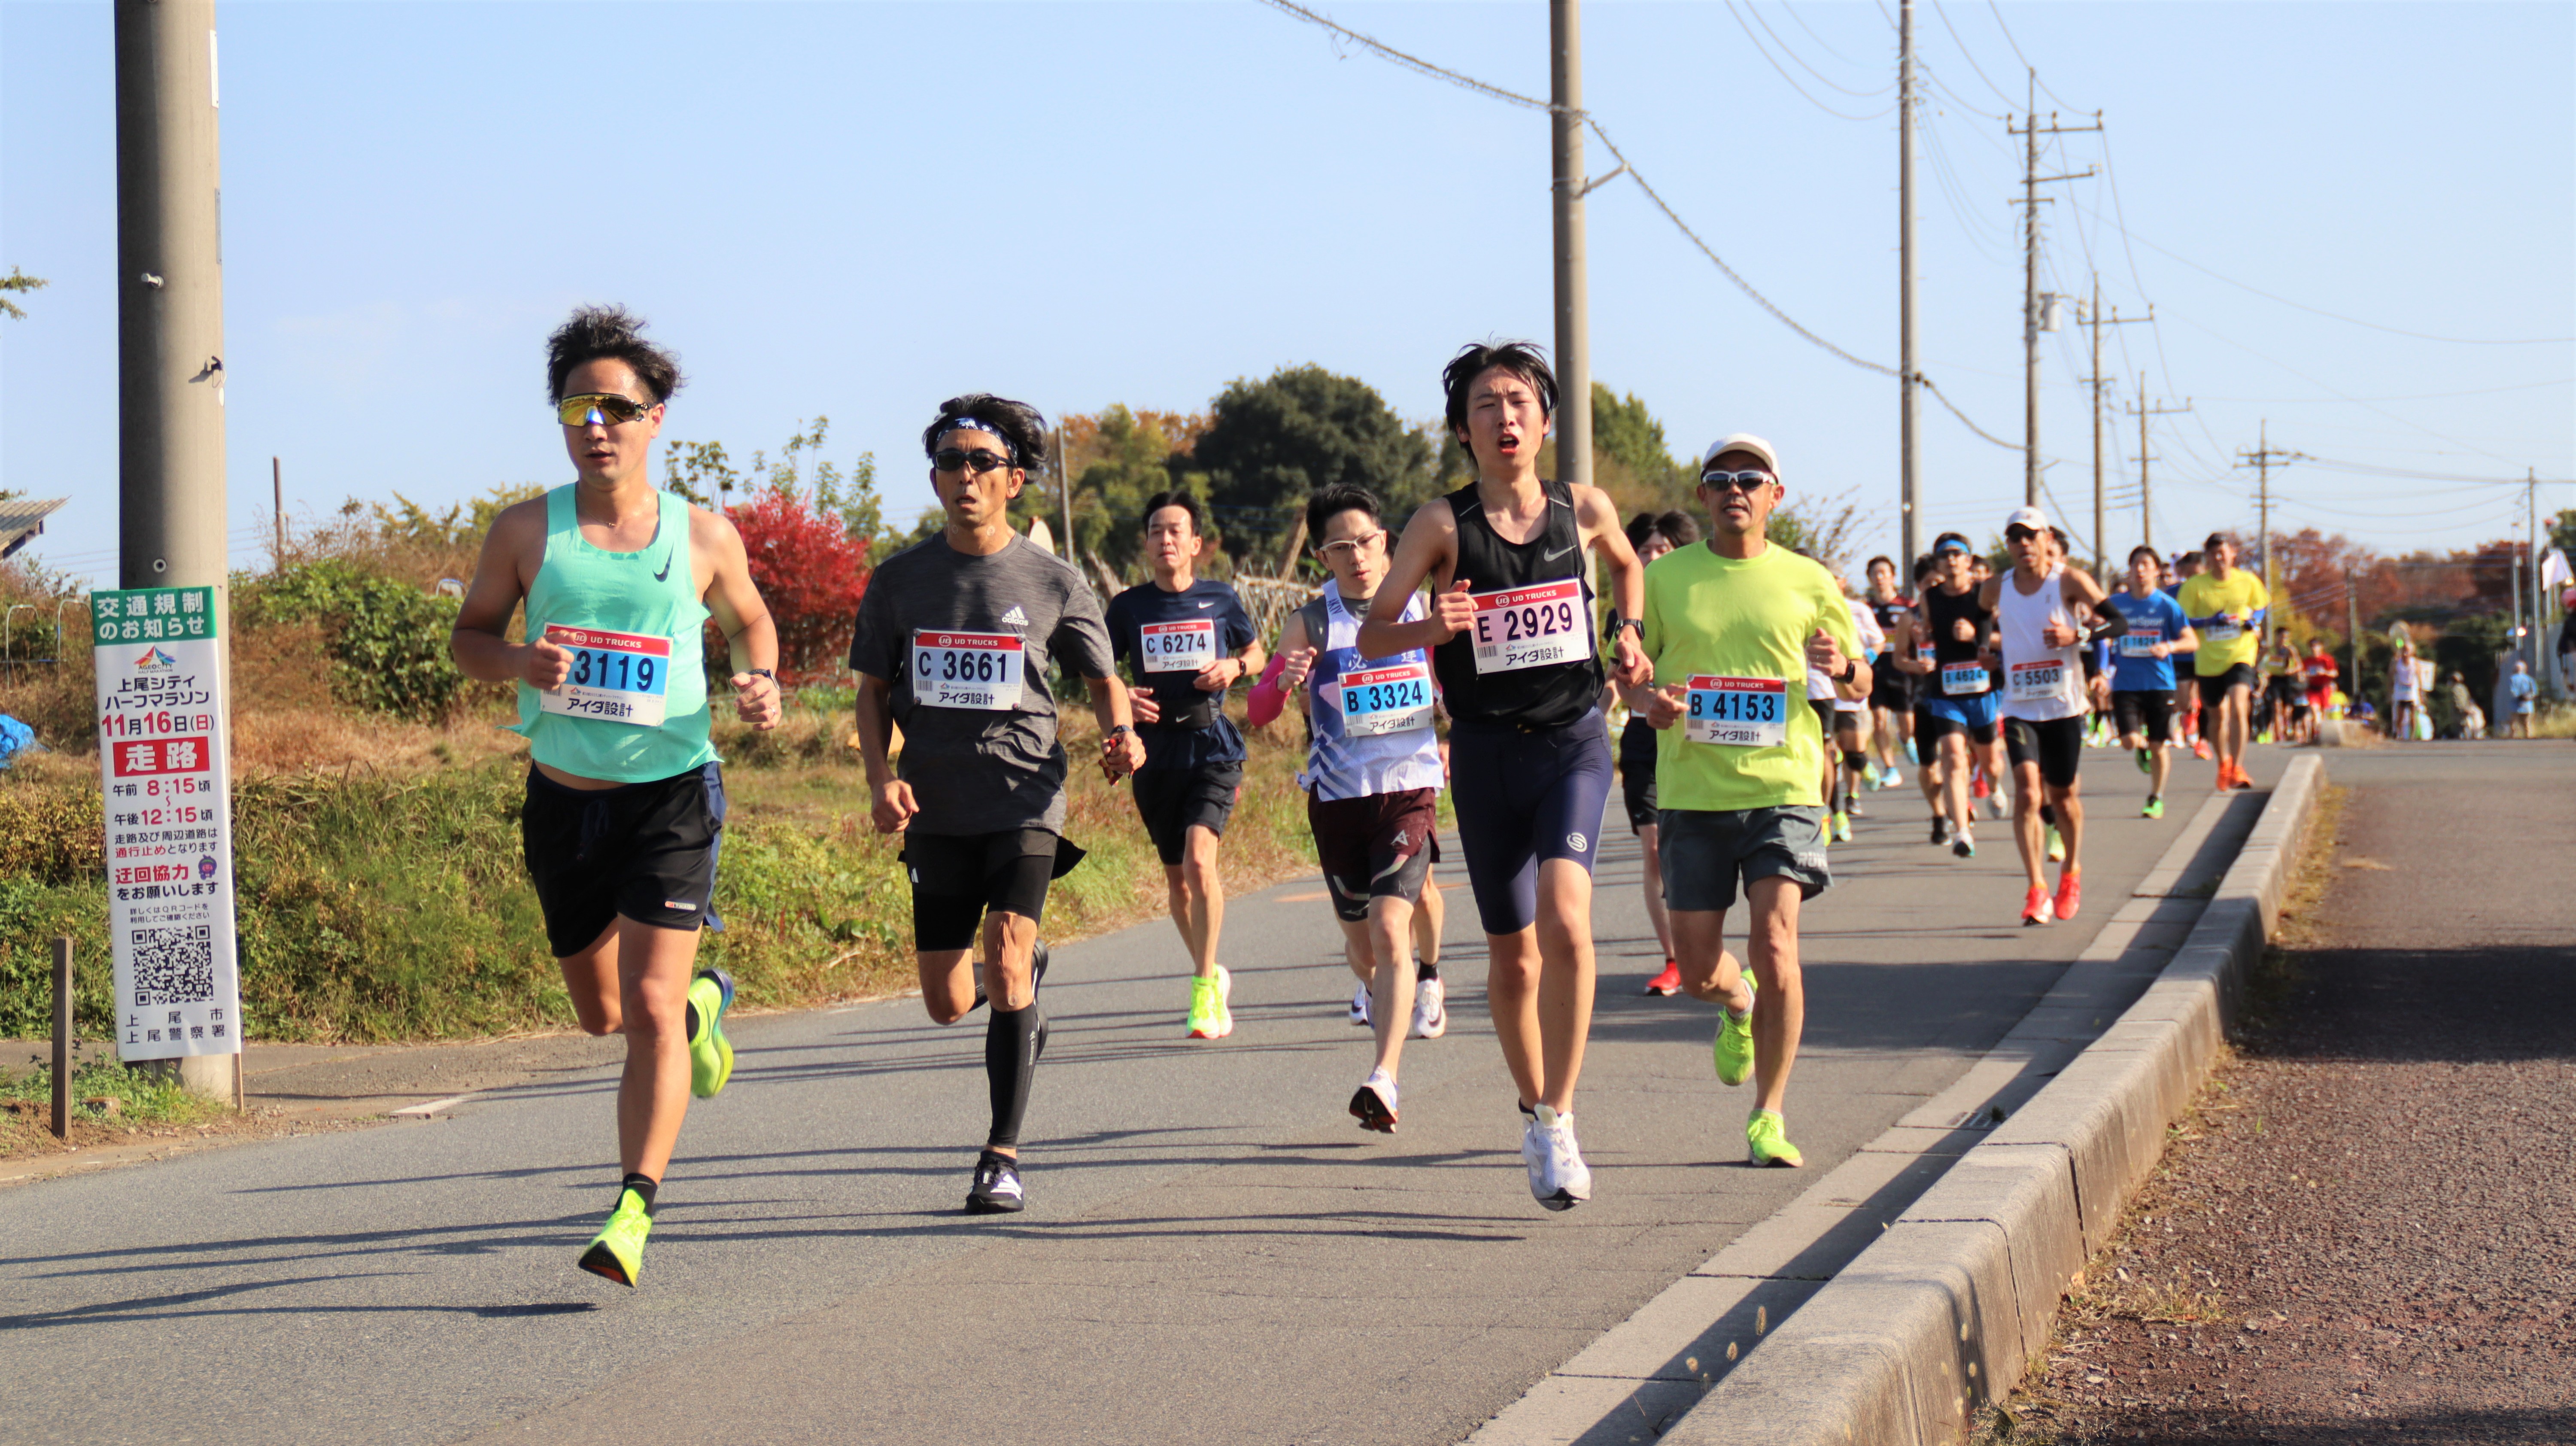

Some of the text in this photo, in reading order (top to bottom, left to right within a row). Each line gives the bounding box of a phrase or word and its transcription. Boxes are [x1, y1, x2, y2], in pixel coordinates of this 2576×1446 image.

[1525, 590, 1557, 600] TRUCKS
[97, 591, 203, 619] 交通規制
[99, 617, 204, 640] のお知らせ
[1002, 617, 1029, 626] adidas
[1477, 603, 1572, 643] E 2929
[605, 638, 642, 648] TRUCKS
[1146, 633, 1206, 653] C 6274
[1506, 646, 1564, 666] アイダ設計
[574, 650, 654, 692] 3119
[918, 651, 1006, 682] C 3661
[1386, 671, 1410, 679] TRUCKS
[117, 675, 195, 693] 上尾シティ
[2026, 668, 2059, 685] 5503
[105, 691, 209, 710] ハーフマラソン
[939, 692, 995, 705] アイダ設計
[1347, 680, 1422, 712] B 3324
[567, 698, 633, 717] アイダ設計
[1691, 693, 1774, 721] B 4153
[102, 711, 214, 737] 11月16日(日)
[1709, 729, 1761, 741] アイダ設計
[126, 741, 197, 772] 走路
[115, 828, 218, 845] 走路及び周辺道路は
[115, 841, 217, 859] 通行止めとなります
[1797, 851, 1828, 867] RUN
[115, 863, 189, 884] 迂回協力
[117, 882, 218, 901] をお願いします
[130, 912, 210, 924] 利用してご確認ください
[125, 1008, 223, 1027] 上尾市
[125, 1024, 225, 1044] 上尾警察署
